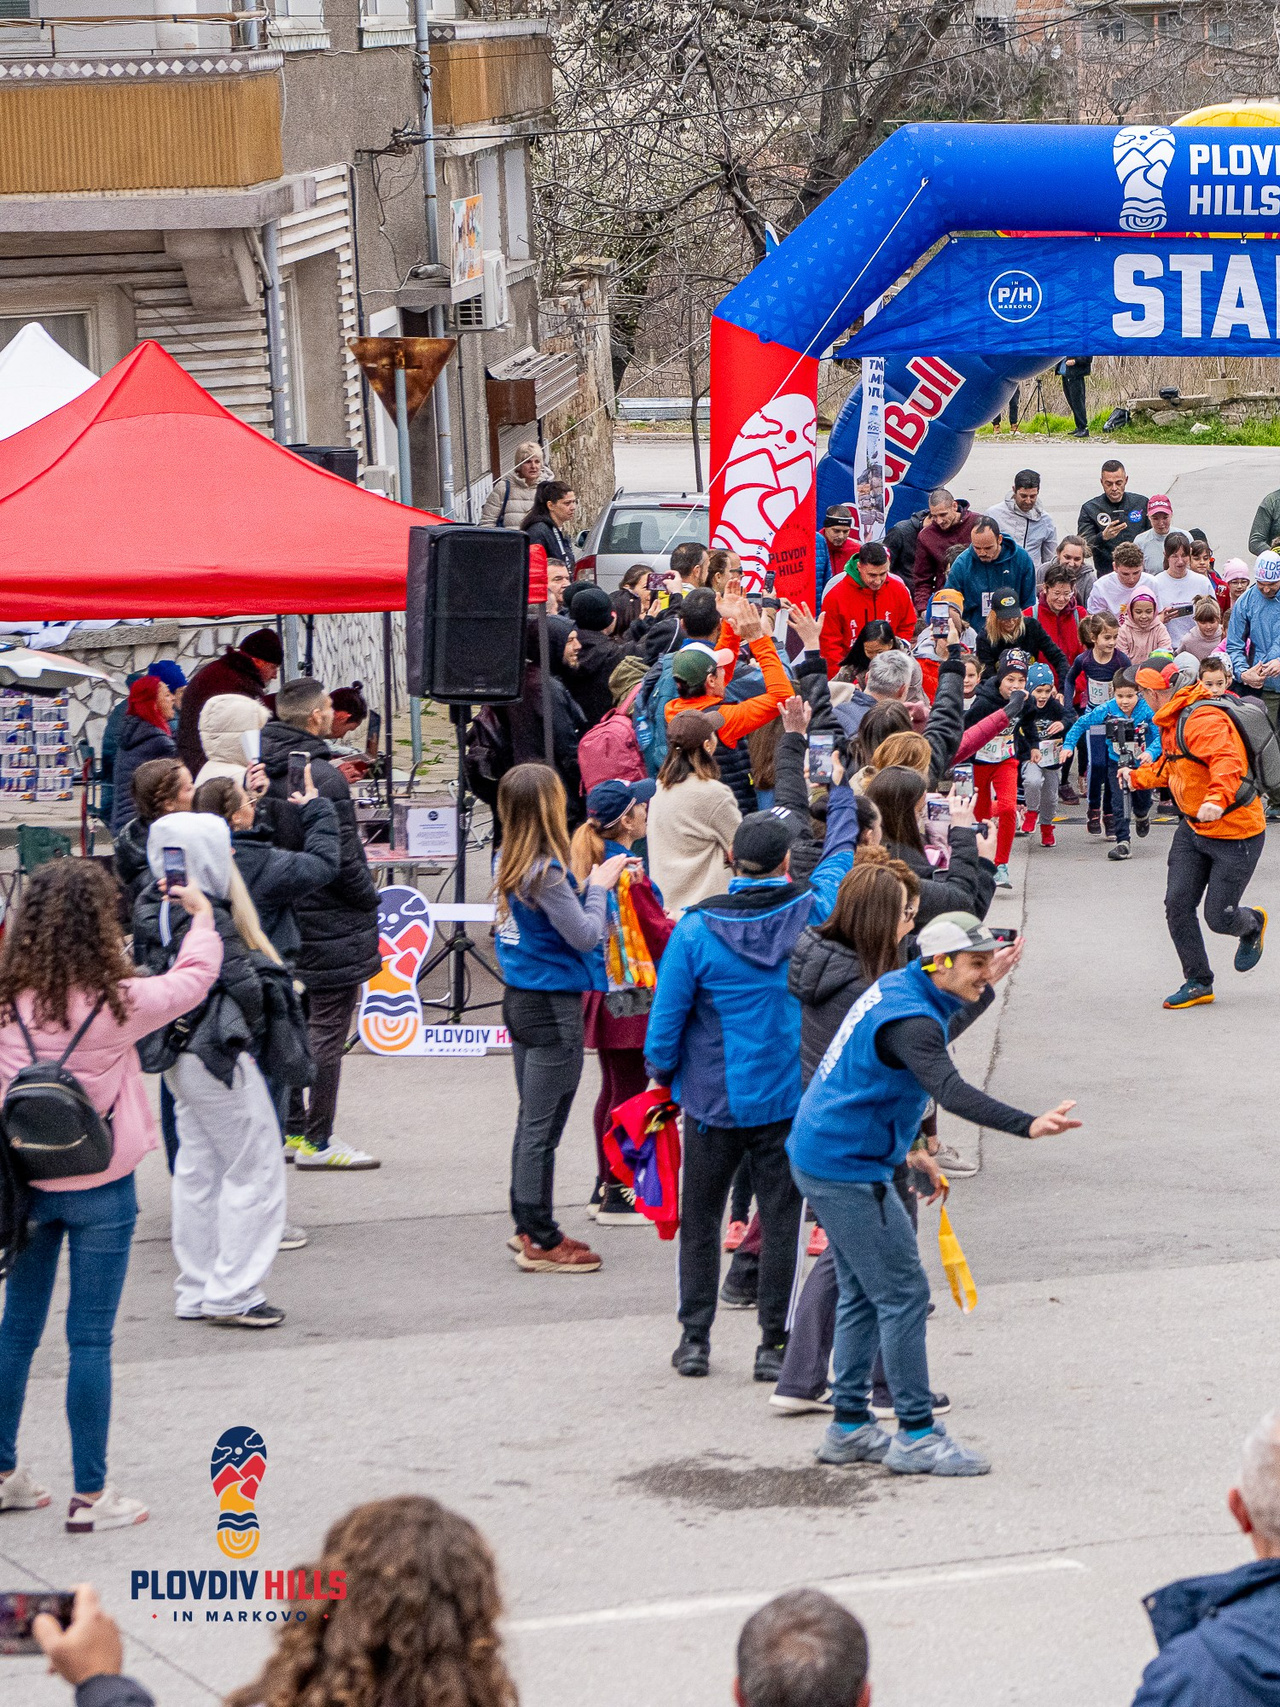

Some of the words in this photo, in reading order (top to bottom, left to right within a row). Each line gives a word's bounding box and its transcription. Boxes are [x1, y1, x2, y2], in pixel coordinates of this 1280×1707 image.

[1189, 185, 1280, 216] HILLS
[998, 287, 1033, 304] P/H
[768, 545, 807, 565] PLOVDIV
[778, 561, 804, 577] HILLS
[1257, 559, 1280, 571] RIDE
[1091, 686, 1104, 697] 125
[425, 1028, 490, 1044] PLOVDIV
